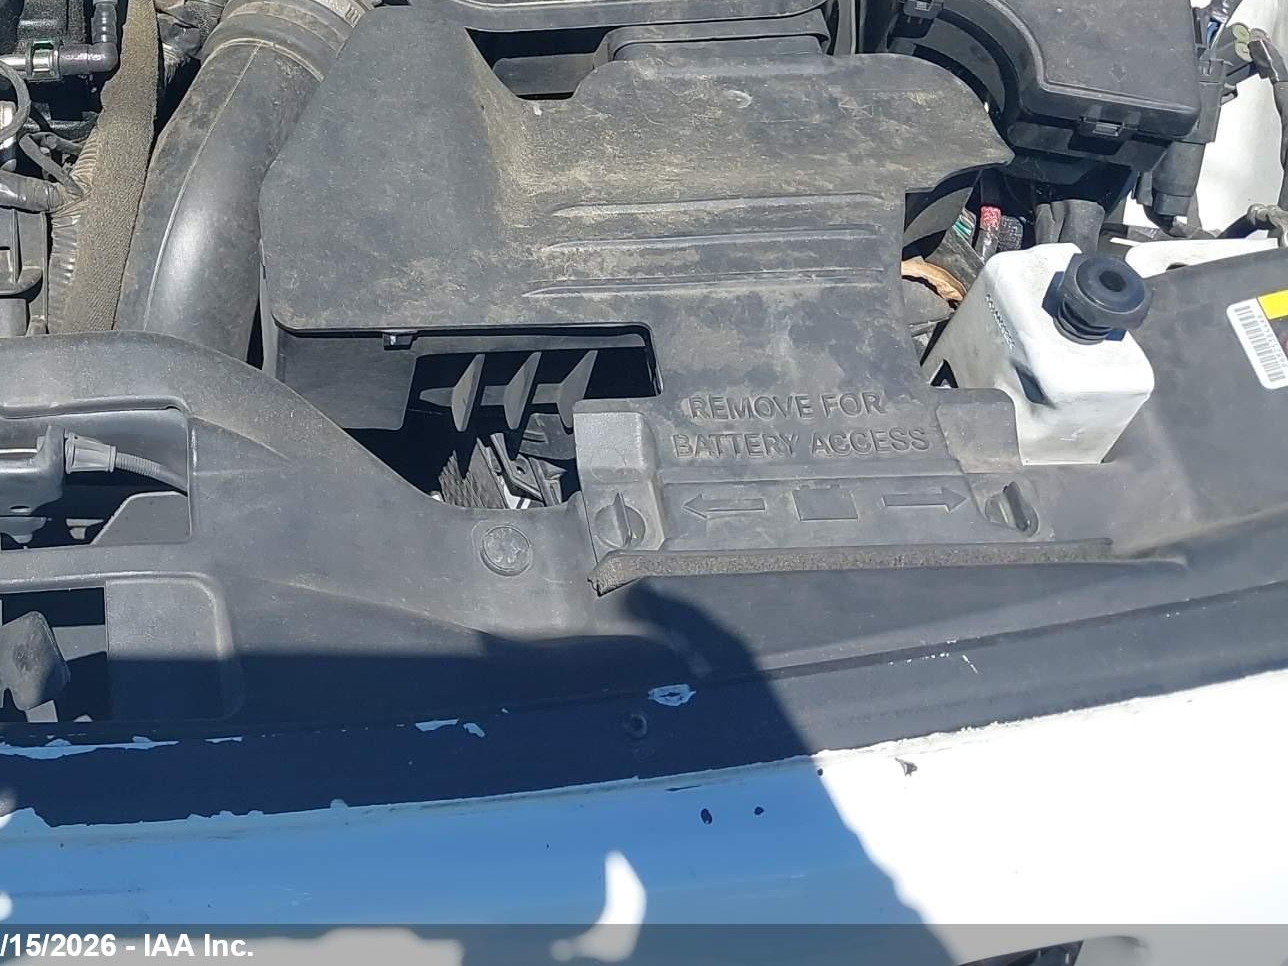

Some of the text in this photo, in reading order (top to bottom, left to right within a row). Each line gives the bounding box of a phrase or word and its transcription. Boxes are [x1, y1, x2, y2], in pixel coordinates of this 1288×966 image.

[688, 391, 887, 421] REMOVE FOR
[672, 426, 931, 458] BATTERY ACCESS
